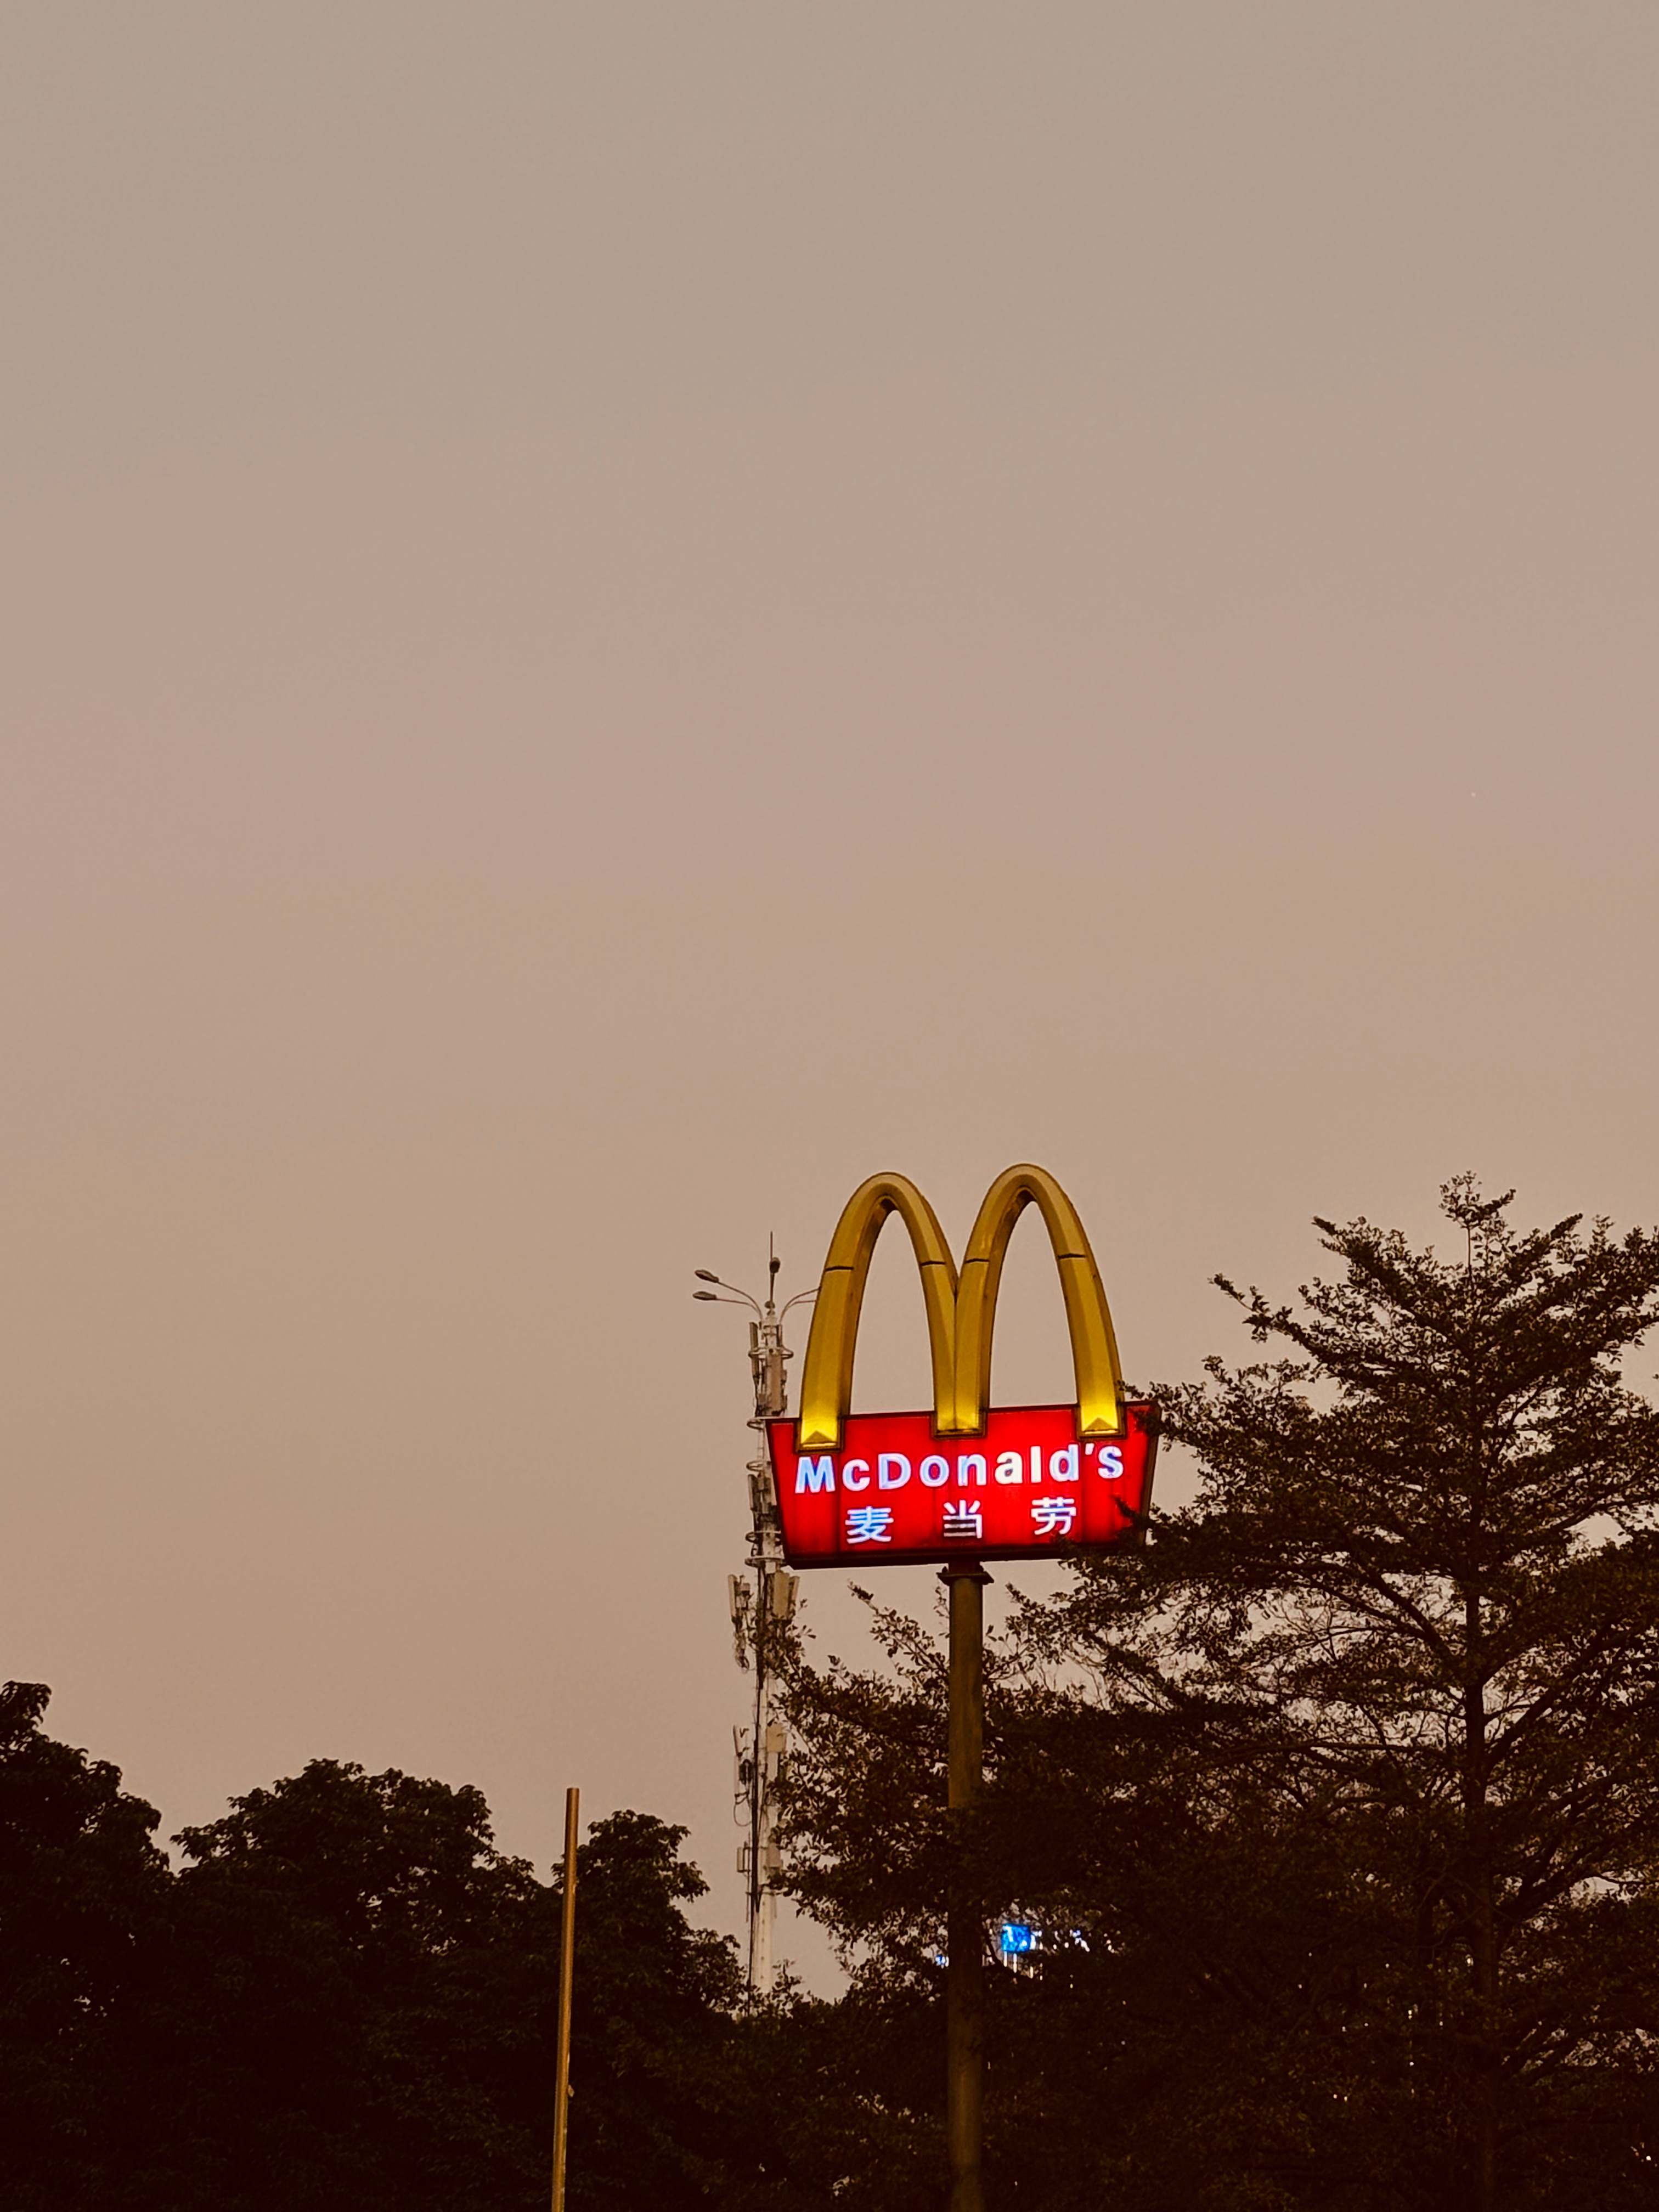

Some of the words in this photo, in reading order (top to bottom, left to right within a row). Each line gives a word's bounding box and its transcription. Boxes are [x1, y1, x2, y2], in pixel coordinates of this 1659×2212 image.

[795, 1443, 1124, 1494] McDonald's
[845, 1497, 1077, 1544] 麦当劳
